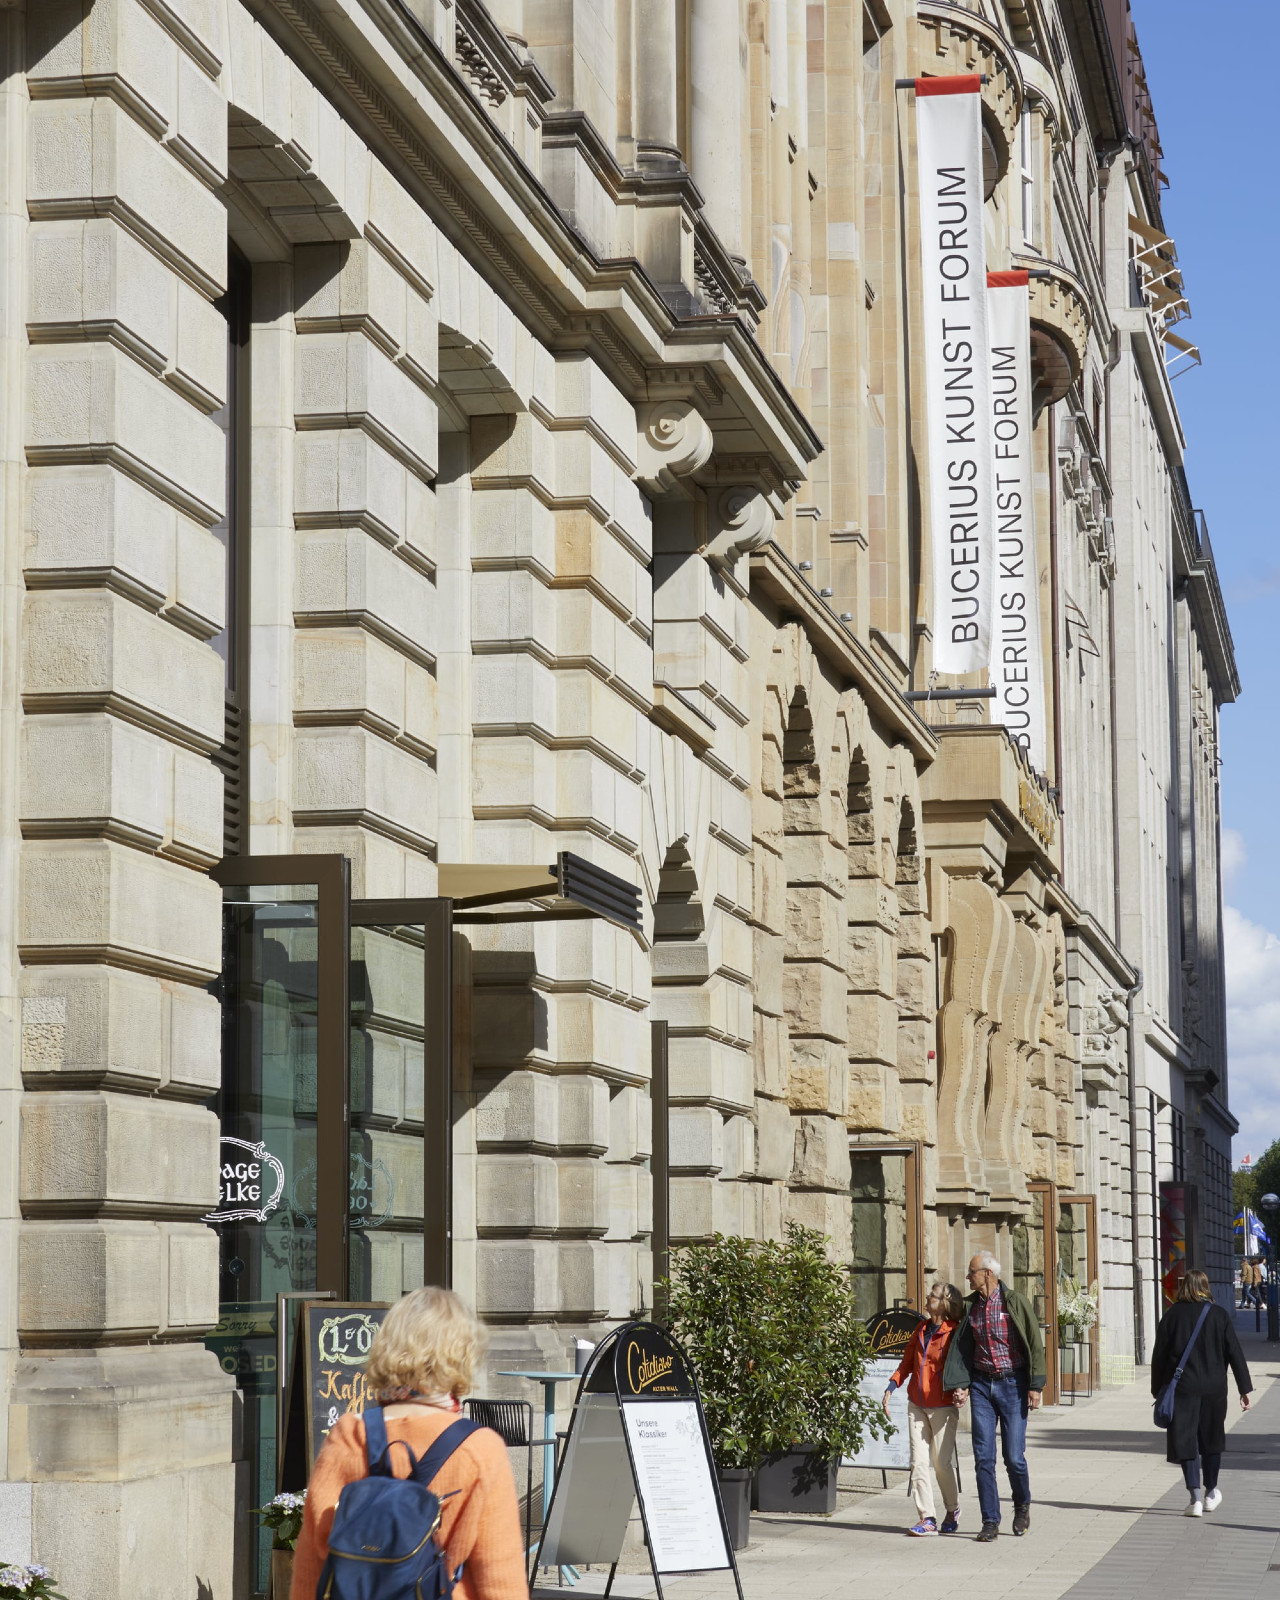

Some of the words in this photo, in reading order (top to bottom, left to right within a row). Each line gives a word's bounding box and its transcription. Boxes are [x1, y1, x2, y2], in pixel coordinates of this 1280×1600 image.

[936, 166, 970, 302] FORUM
[941, 317, 976, 444] KUNST
[990, 346, 1019, 460] FORUM
[946, 459, 980, 644] BUCERIUS
[996, 472, 1024, 579] KUNST
[216, 1317, 257, 1335] Sorry
[627, 1341, 674, 1394] Cotidiano
[635, 1418, 659, 1428] Unsere
[638, 1429, 668, 1439] Klassiker
